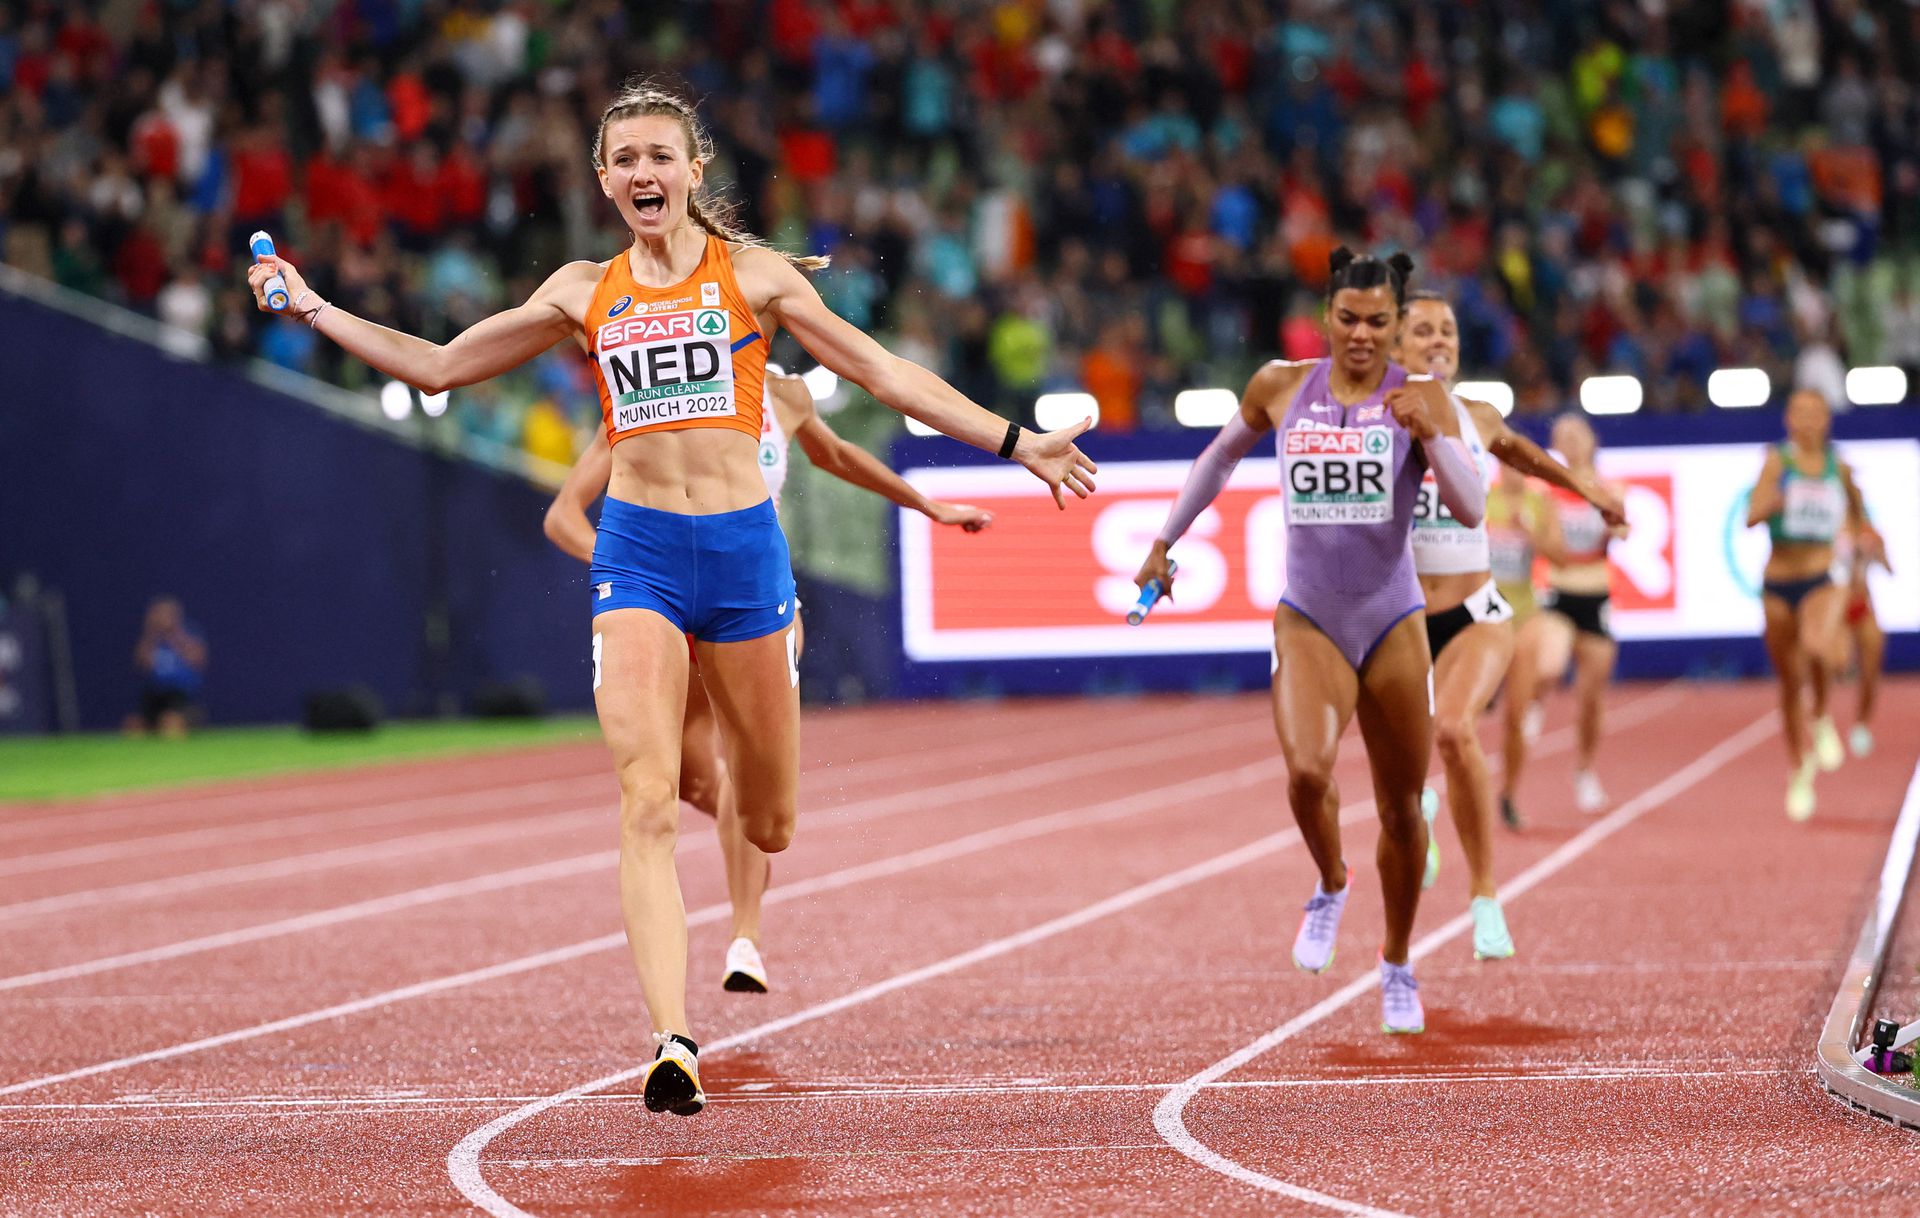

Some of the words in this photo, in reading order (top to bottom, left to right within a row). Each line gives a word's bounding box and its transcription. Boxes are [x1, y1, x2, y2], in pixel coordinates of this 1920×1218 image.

[649, 296, 693, 307] NEDERLANDSE
[602, 316, 691, 346] SPAR
[609, 341, 720, 395] NED
[638, 390, 661, 401] RUN
[619, 400, 680, 425] MUNICH
[686, 396, 728, 414] 2022
[1287, 433, 1361, 453] SPAR
[1290, 460, 1386, 495] GBR
[1291, 506, 1346, 520] MUNICH
[1352, 505, 1386, 519] 2022
